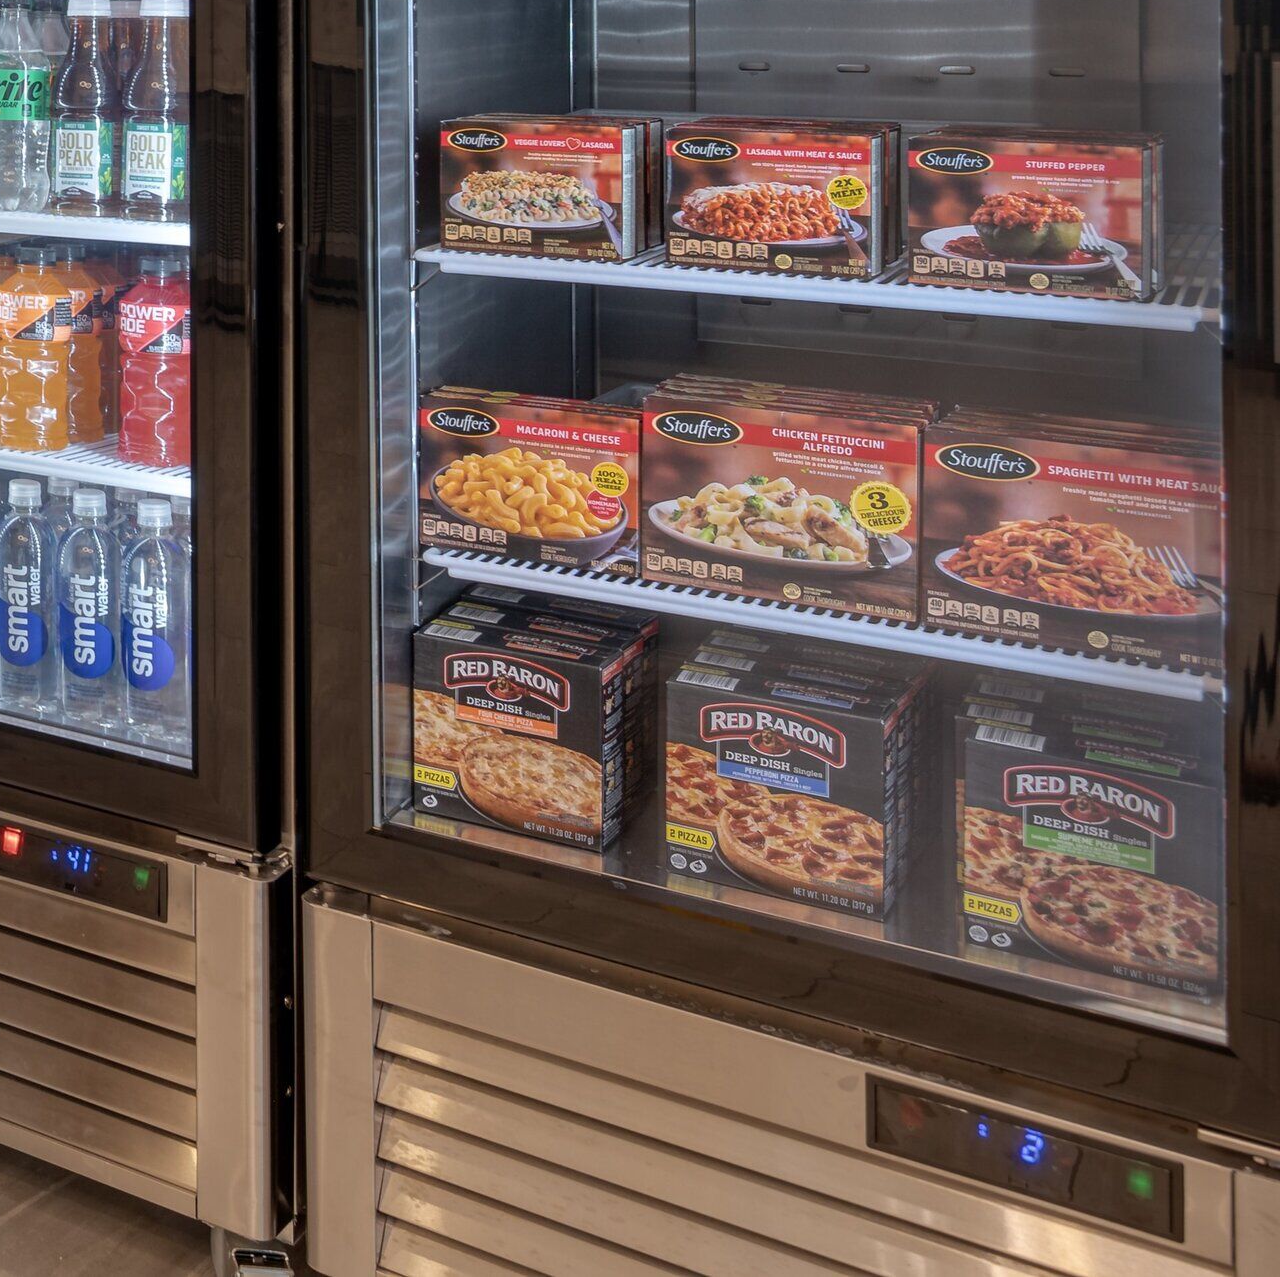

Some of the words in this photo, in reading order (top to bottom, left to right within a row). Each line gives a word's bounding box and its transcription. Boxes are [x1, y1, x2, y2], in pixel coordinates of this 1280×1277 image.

[60, 132, 94, 150] GOLD
[130, 135, 166, 153] GOLD
[456, 133, 500, 148] Stouffer's
[680, 142, 732, 158] Stouffer's
[747, 148, 782, 157] LASAGNA
[784, 150, 805, 158] WITH
[806, 151, 827, 159] MEAT
[836, 152, 862, 160] SAUCE
[60, 152, 92, 167] PEAK
[130, 153, 165, 170] PEAK
[925, 153, 984, 170] Stouffer's
[1025, 161, 1066, 170] STUFFED
[1068, 163, 1105, 172] PEPPER
[830, 188, 864, 199] MEAT
[671, 240, 683, 248] 360
[916, 256, 928, 265] 190
[120, 304, 176, 322] POWER
[436, 412, 491, 432] Stouffer's
[663, 417, 732, 439] Stouffer's
[516, 425, 569, 439] MACARONI
[572, 432, 579, 440] &
[583, 433, 621, 445] CHEESE
[772, 428, 818, 442] CHICKEN
[822, 434, 885, 450] FETTUCCINI
[773, 451, 792, 459] grilled
[803, 442, 853, 456] ALFREDO
[947, 449, 1026, 475] Stouffer's
[595, 477, 624, 486] REAL
[598, 470, 624, 479] 100%
[1047, 465, 1114, 482] SPAGHETTI
[1118, 473, 1152, 486] WITH
[1155, 478, 1189, 491] MEAT
[597, 483, 622, 491] CHEESE
[1088, 490, 1108, 498] made
[868, 491, 889, 510] 3
[1118, 499, 1134, 507] beef
[1151, 503, 1167, 511] pork
[860, 509, 906, 519] DELICIOUS
[868, 516, 902, 528] CHEESES
[648, 554, 660, 564] 390
[30, 566, 41, 606] water
[98, 577, 109, 617] water
[803, 594, 814, 602] COOK
[930, 599, 943, 608] 410
[4, 564, 28, 654] smart
[156, 587, 168, 629] water
[856, 602, 866, 611] NET
[70, 574, 96, 665] smart
[128, 584, 153, 677] smart
[1111, 643, 1125, 652] COOK
[1127, 644, 1162, 659] THOROUGHLY
[453, 659, 490, 679] RED
[492, 659, 560, 699] BARON
[466, 696, 495, 709] DEEP
[496, 702, 523, 715] DISH
[525, 711, 551, 721] Singles
[710, 710, 752, 731] RED
[756, 711, 834, 755] BARON
[725, 750, 758, 765] DEEP
[760, 758, 791, 771] DISH
[793, 767, 823, 779] Singles
[417, 769, 423, 778] 2
[424, 770, 450, 785] PIZZAS
[745, 767, 779, 779] PEPPERONI
[781, 773, 799, 784] PIZZA
[1015, 774, 1065, 797] RED
[1069, 775, 1162, 824] BARON
[524, 821, 536, 831] NET
[1033, 815, 1071, 830] DEEP
[1073, 823, 1110, 839] DISH
[1112, 834, 1148, 848] Singles
[670, 828, 676, 838] 2
[676, 830, 708, 846] PIZZAS
[1057, 833, 1093, 846] SUPREME
[1096, 840, 1119, 851] PIZZA
[793, 886, 805, 897] NET
[807, 889, 820, 900] WT.
[968, 898, 975, 909] 2
[977, 900, 1013, 918] PIZZAS
[1112, 965, 1128, 976] NET
